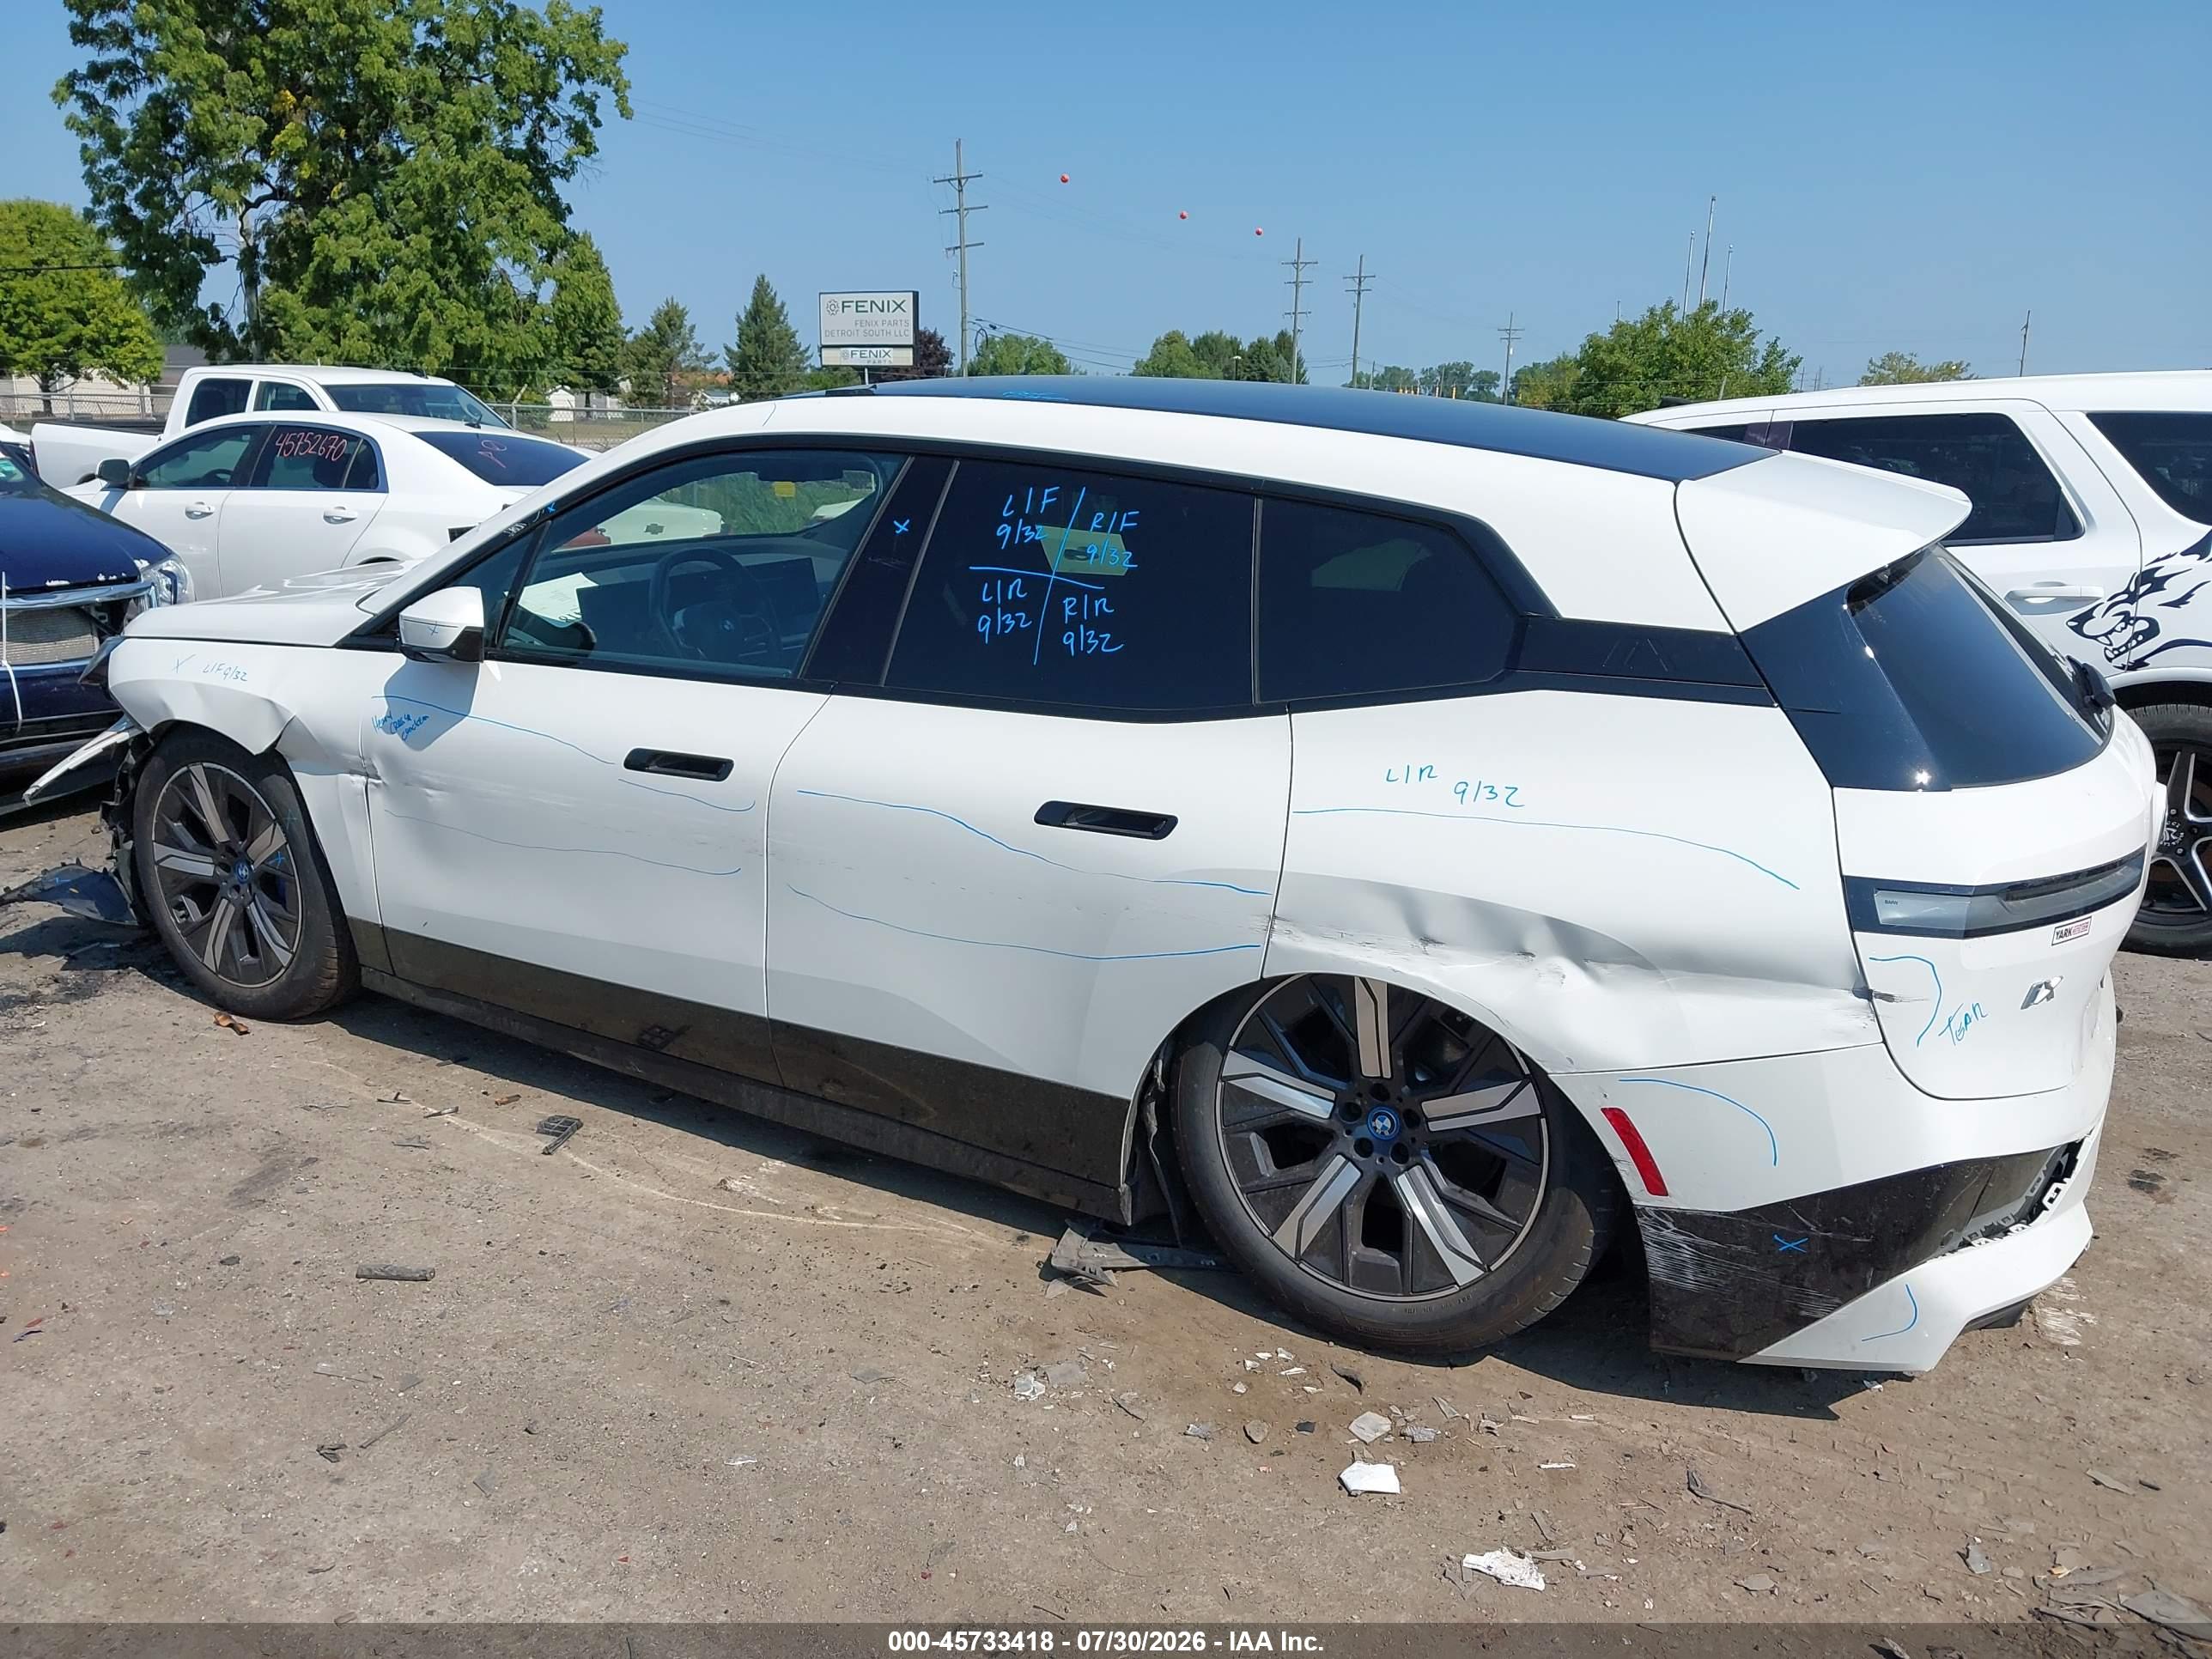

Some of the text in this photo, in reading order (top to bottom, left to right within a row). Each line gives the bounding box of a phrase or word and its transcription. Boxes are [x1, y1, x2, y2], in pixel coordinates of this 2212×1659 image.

[842, 300, 907, 313] FENIX
[854, 319, 909, 328] FENIX PARTS
[824, 329, 859, 337] DETROIT
[850, 349, 891, 359] FENIX
[996, 519, 1048, 550] 9/32
[1454, 781, 1525, 807] 9/32
[2056, 927, 2074, 940] YARK
